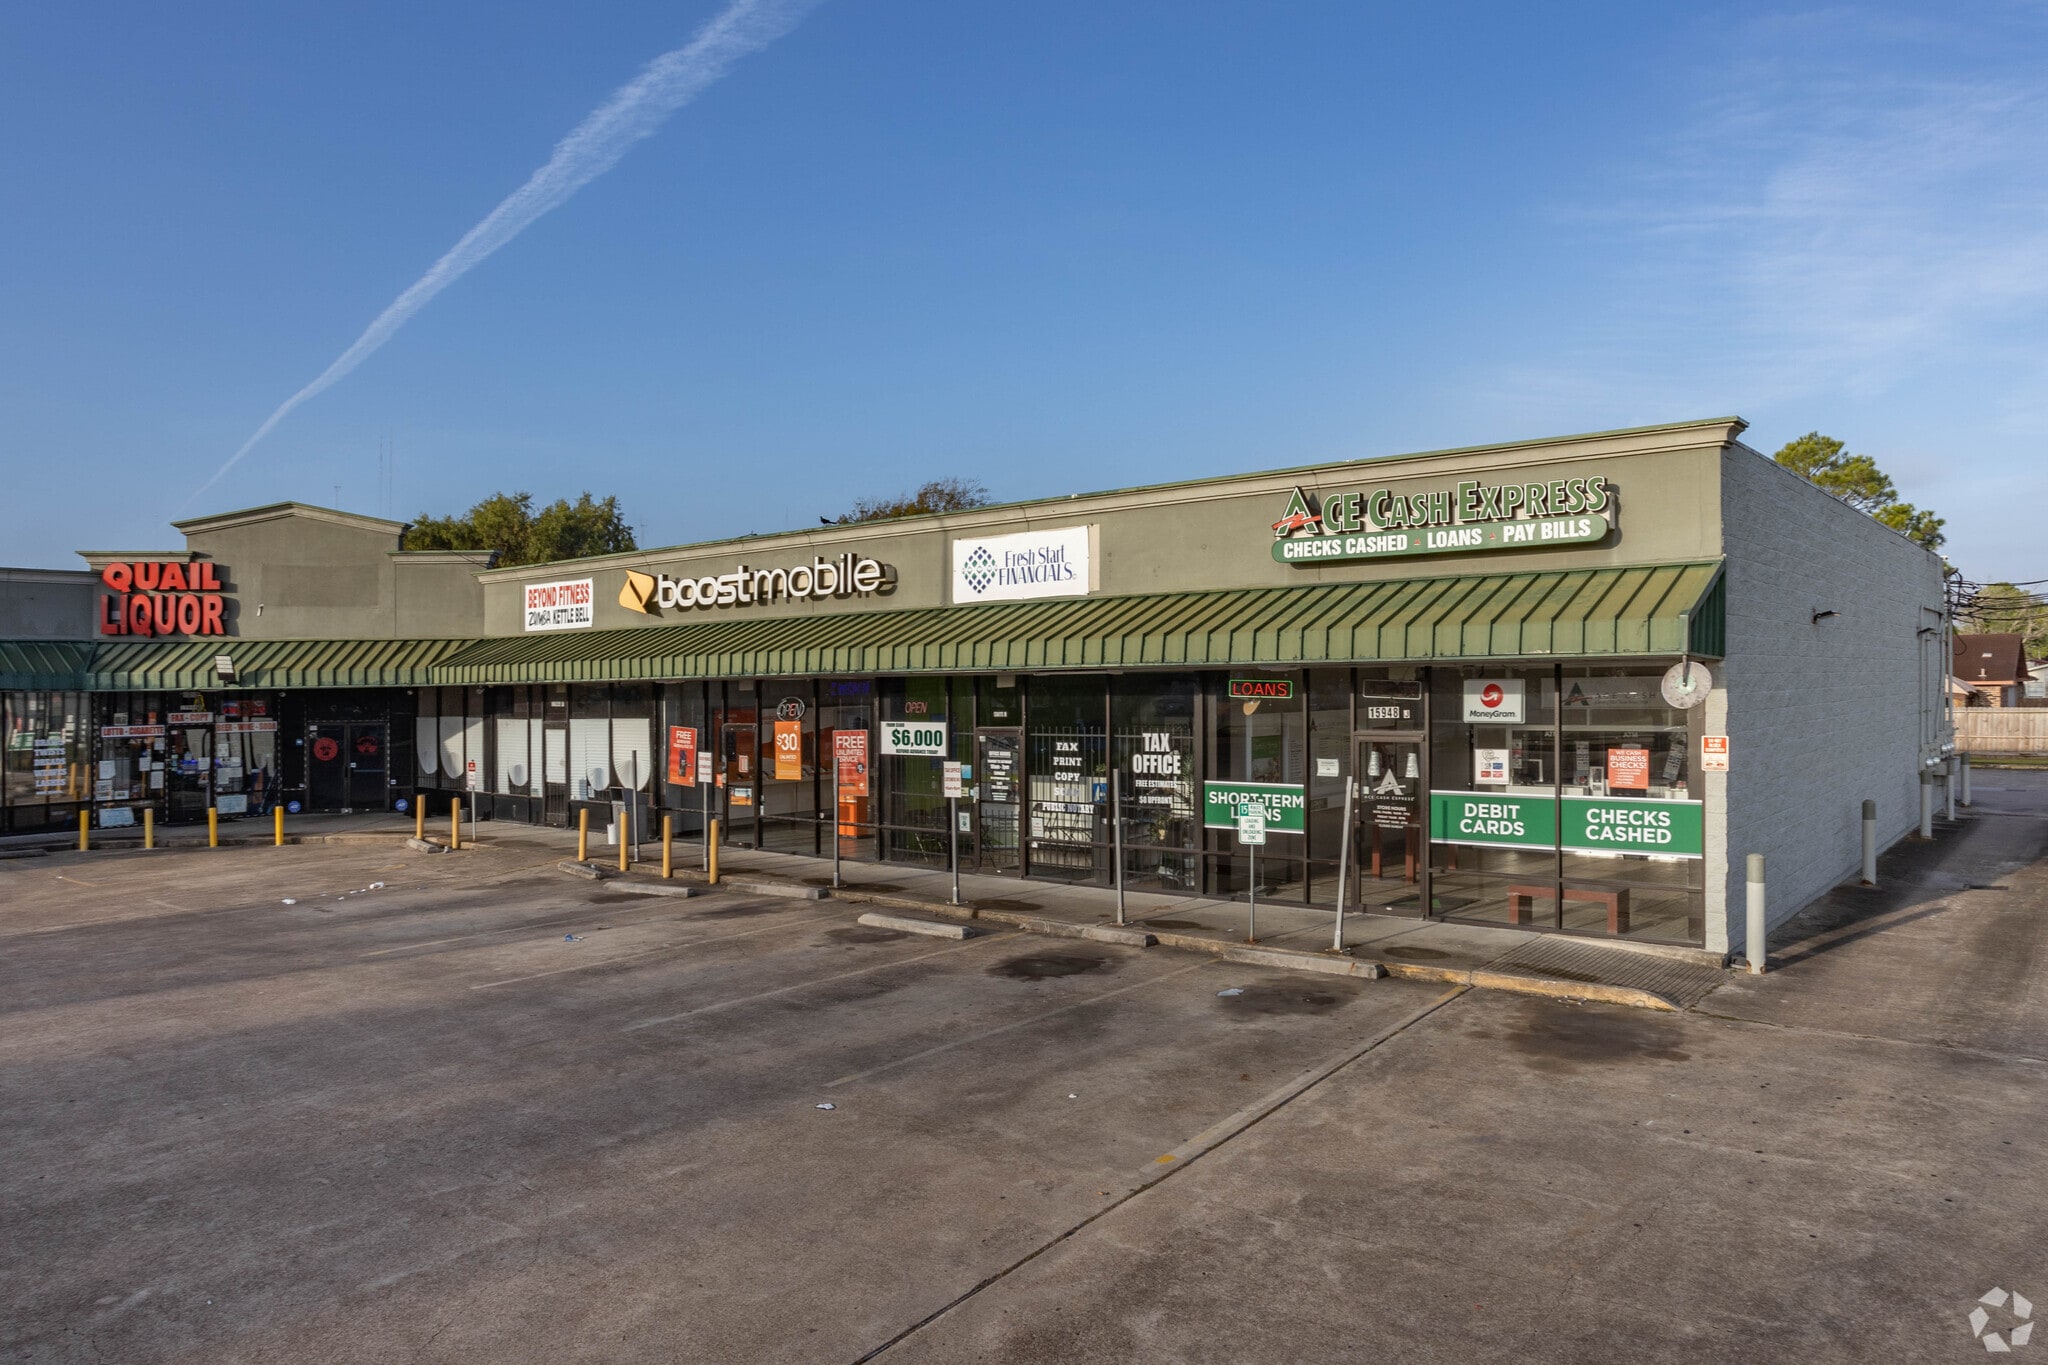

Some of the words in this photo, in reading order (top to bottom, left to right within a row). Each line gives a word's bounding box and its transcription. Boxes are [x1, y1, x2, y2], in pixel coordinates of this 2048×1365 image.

[1272, 486, 1360, 537] ACE
[1368, 489, 1450, 529] CASH
[1457, 476, 1607, 522] EXPRESS
[1283, 540, 1342, 558] CHECKS
[1345, 534, 1408, 555] CASHED
[1427, 528, 1482, 549] LOANS
[1503, 523, 1536, 543] PAY
[1541, 519, 1591, 540] BILLS
[1005, 548, 1035, 567] Fresh
[1038, 544, 1065, 565] Start
[102, 561, 221, 593] QUAIL
[999, 561, 1073, 586] FINANCIALS
[528, 587, 556, 608] BEYOND
[559, 583, 590, 606] FITNESS
[100, 593, 225, 638] LIQUOR
[553, 608, 574, 624] KETTLE
[576, 607, 589, 622] BELL
[1232, 682, 1288, 697] LOANS
[905, 701, 927, 713] OPEN
[1370, 707, 1399, 718] 15948
[1469, 710, 1516, 719] MoneyGram
[676, 730, 692, 740] FREE
[776, 733, 798, 751] $30
[836, 735, 865, 749] FREE
[892, 728, 943, 747] $6,000
[1142, 732, 1170, 752] TAX
[836, 748, 865, 756] UNLIMITED
[1056, 742, 1079, 751] FAX
[837, 755, 858, 763] ERVICE
[1052, 757, 1082, 766] PRINT
[1132, 754, 1181, 774] OFFICE
[1610, 761, 1647, 769] CHECKS!
[1055, 772, 1080, 781] COPY
[1135, 779, 1148, 787] FREE
[1149, 780, 1176, 788] ESTIMATES
[1209, 791, 1304, 808] SHORT-TERM
[1042, 802, 1065, 812] PUBLIC
[1067, 804, 1094, 814] NOTARY
[1231, 806, 1281, 821] LNS
[1241, 805, 1248, 814] 15
[1464, 803, 1520, 819] DEBIT
[1586, 808, 1671, 827] CHECKS
[1460, 819, 1525, 836] CARDS
[1585, 825, 1672, 844] CASHED
